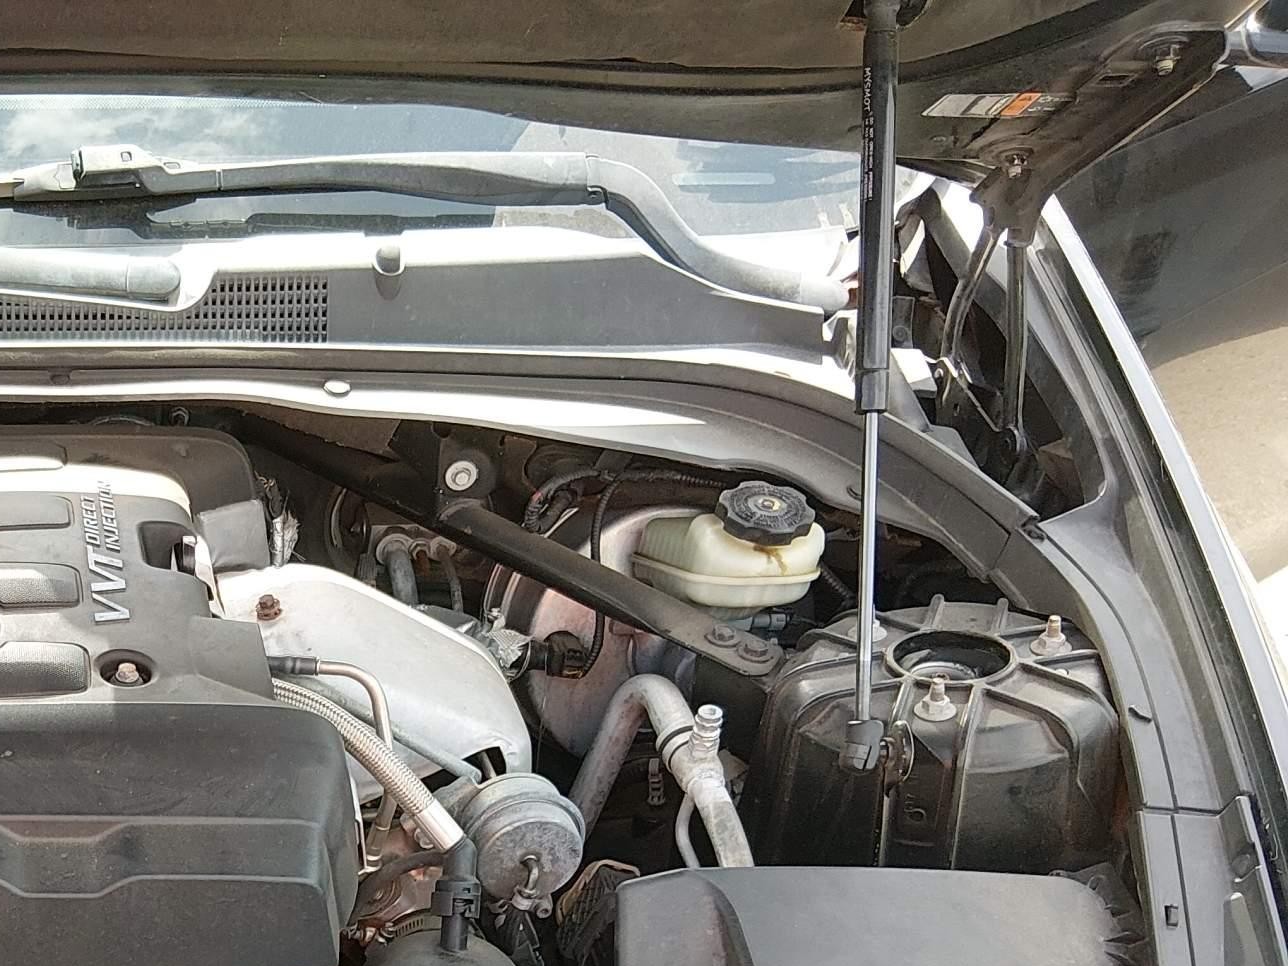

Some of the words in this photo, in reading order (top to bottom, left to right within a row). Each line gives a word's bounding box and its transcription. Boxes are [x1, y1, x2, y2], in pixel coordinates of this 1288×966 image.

[81, 496, 101, 547] DIRECT
[97, 480, 121, 553] INJECTION
[86, 545, 131, 623] VVT
